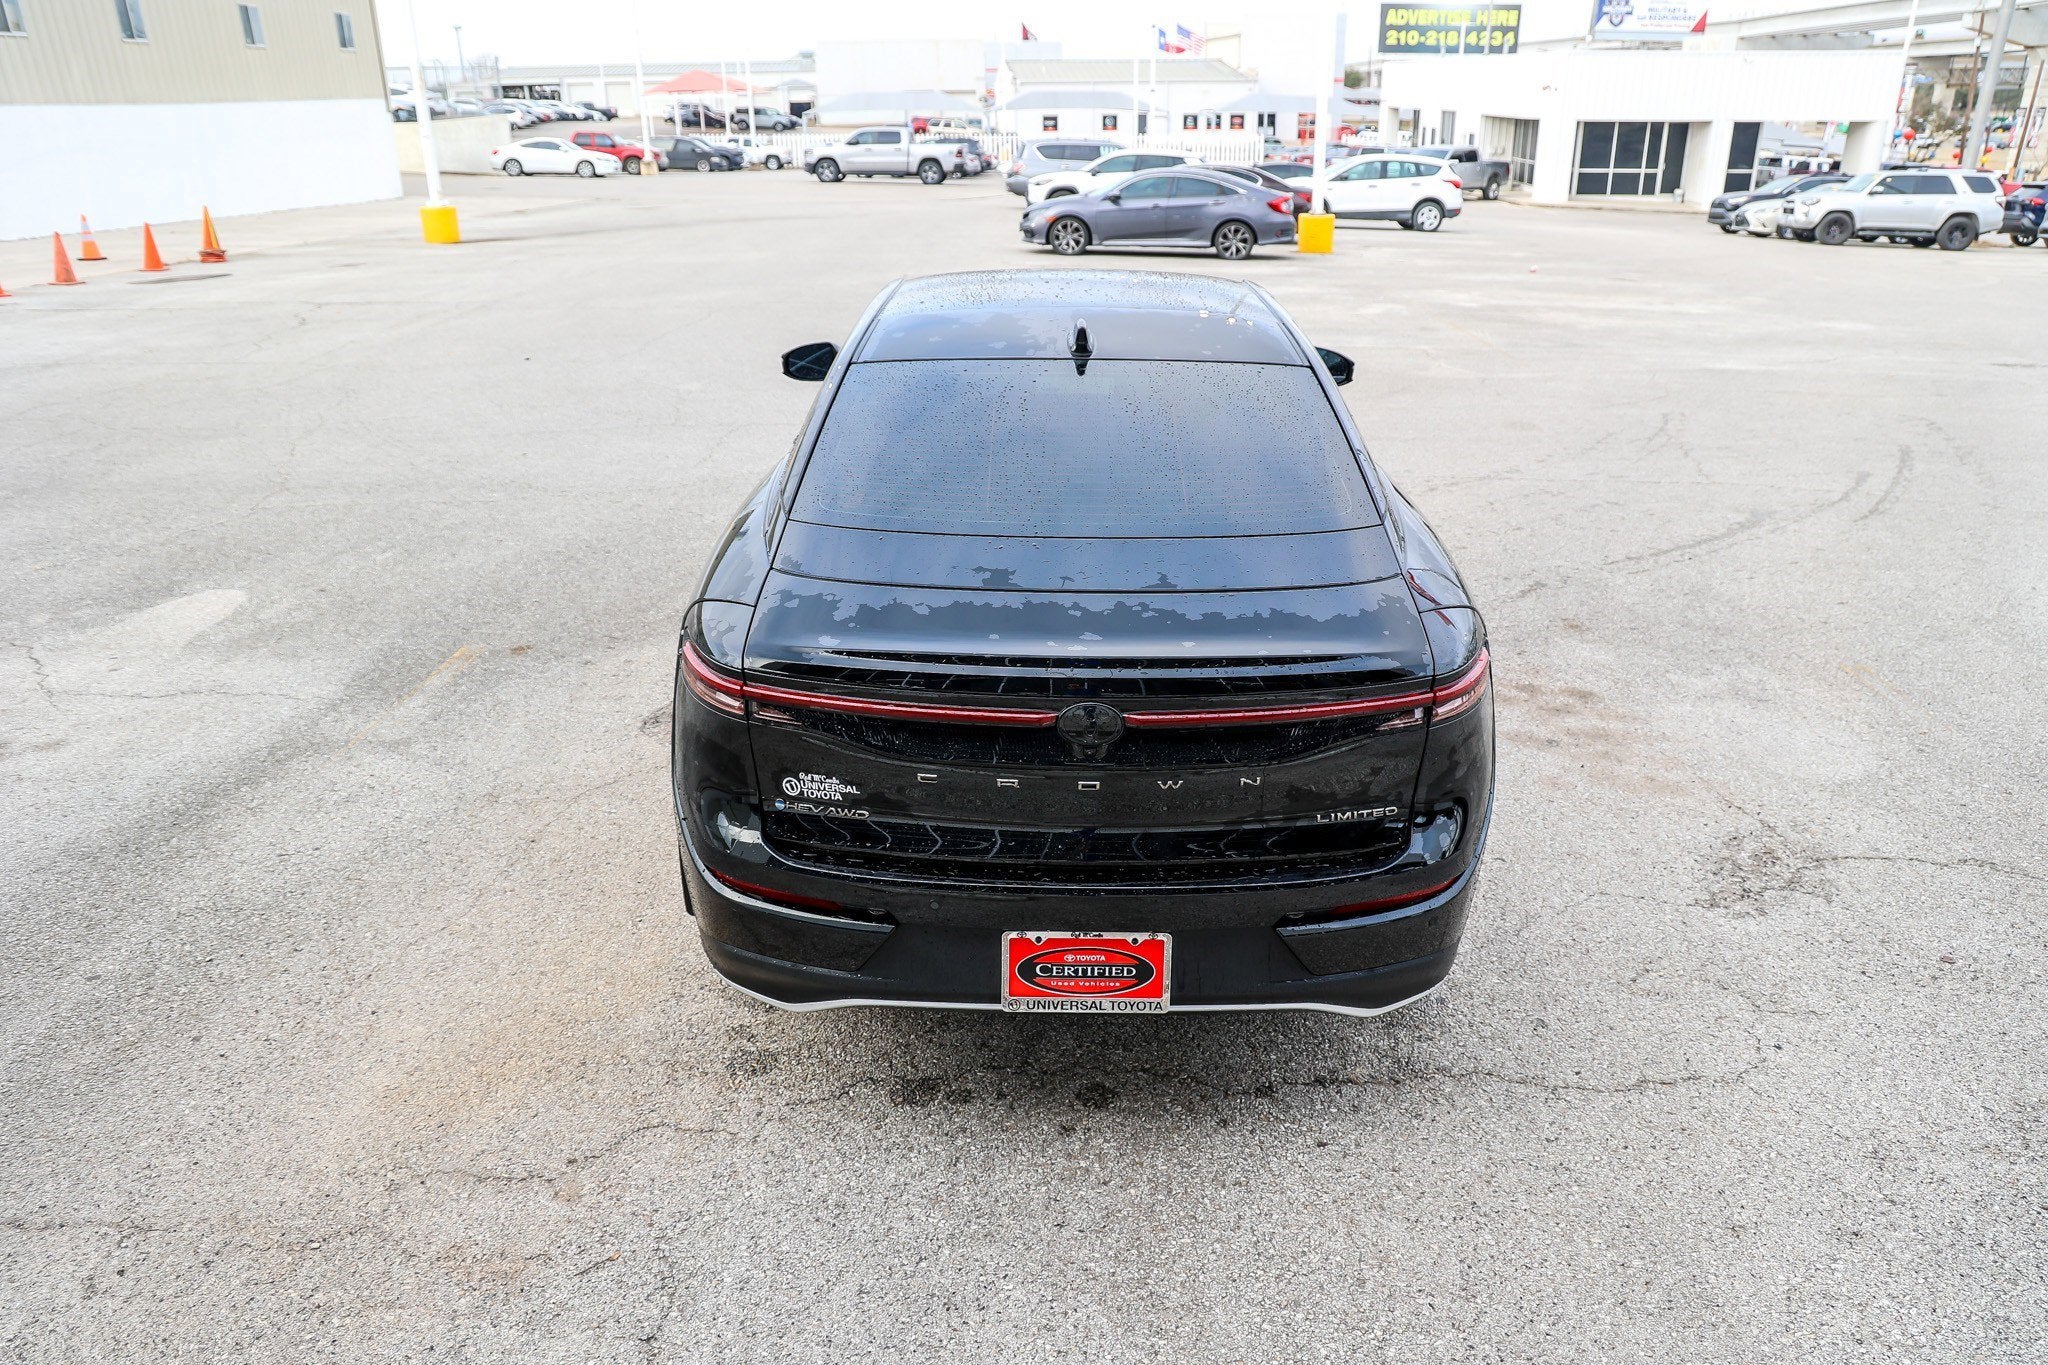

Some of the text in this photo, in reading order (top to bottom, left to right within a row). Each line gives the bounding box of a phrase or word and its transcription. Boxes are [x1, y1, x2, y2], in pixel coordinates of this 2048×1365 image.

[1385, 8, 1519, 26] ADVERTISE HERE
[800, 780, 861, 794] UNIVERSAL
[917, 773, 1261, 791] CROWN
[802, 788, 843, 800] TOYOTA
[786, 801, 870, 819] HEV AWD
[1316, 806, 1398, 823] LIMITED
[1076, 952, 1106, 962] TOYOTA
[1035, 963, 1137, 977] CERTIFIED
[1026, 1000, 1163, 1011] UNIVERSAL TOYOTA
